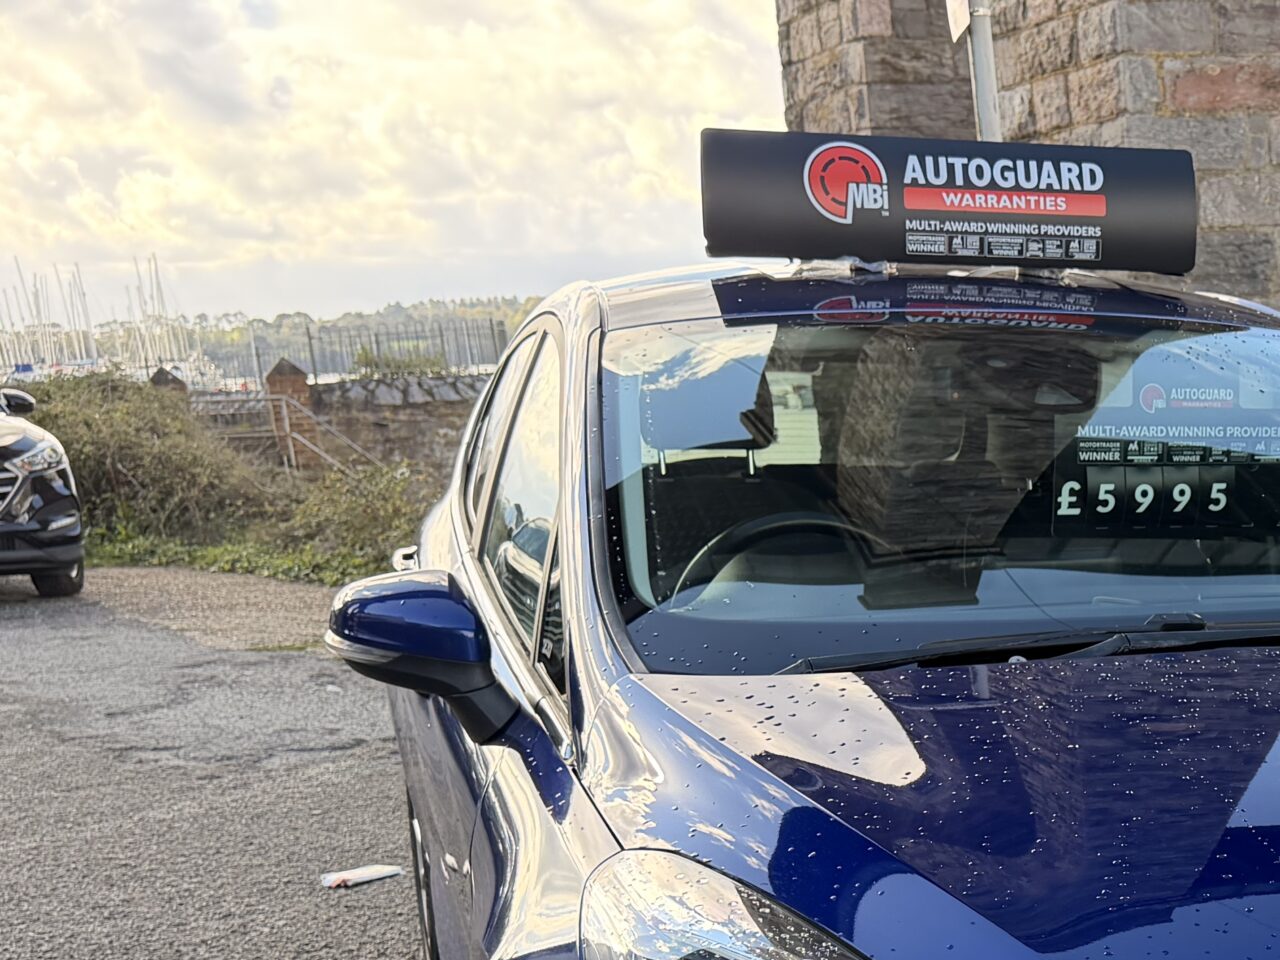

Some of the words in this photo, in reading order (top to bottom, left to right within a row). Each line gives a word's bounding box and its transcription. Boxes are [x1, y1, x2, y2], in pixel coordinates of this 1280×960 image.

[903, 154, 1104, 191] AUTOGUARD
[942, 192, 1067, 211] WARRANTIES
[905, 219, 986, 234] MULTI-AWARD
[987, 223, 1039, 235] WINNING
[1040, 226, 1102, 237] PROVIDERS
[907, 243, 945, 253] WINNER
[1170, 387, 1234, 401] AUTOGUARD
[1077, 425, 1167, 438] MULTI-AWARD
[1168, 425, 1224, 438] WINNING
[1079, 451, 1121, 461] WINNER
